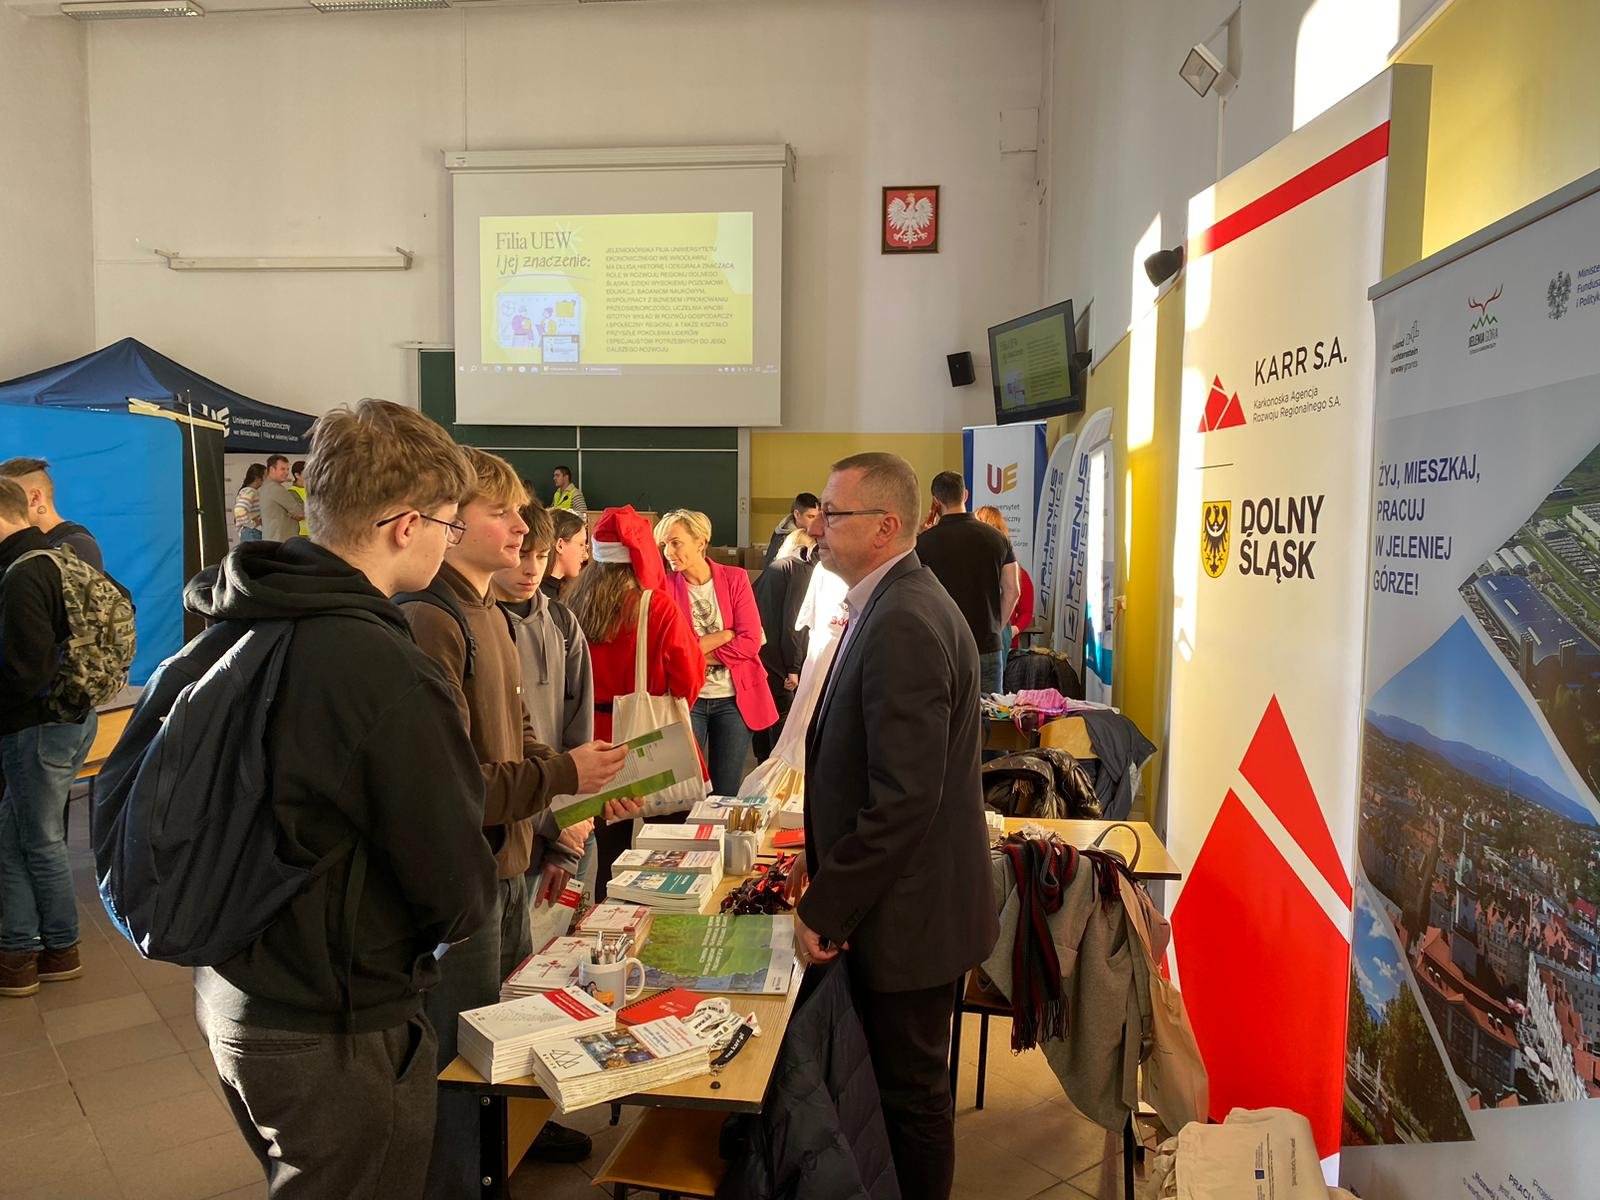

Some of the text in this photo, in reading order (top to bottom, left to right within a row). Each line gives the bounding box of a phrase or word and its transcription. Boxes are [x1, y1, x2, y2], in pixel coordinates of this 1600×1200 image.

[496, 231, 571, 250] Filia UEW
[500, 254, 518, 275] jej
[523, 253, 591, 267] znaczenie:
[1254, 336, 1348, 386] KARR S.A.
[1253, 386, 1318, 409] Karkonoska Agencja
[232, 416, 291, 432] Uniwersytet Ekonomiczny
[1253, 410, 1279, 423] Rozwoju
[1280, 400, 1327, 418] Regionalnego
[986, 462, 1018, 495] UE
[1404, 454, 1480, 484] MIESZKAJ,
[1240, 495, 1325, 535] DOLNY
[1376, 498, 1425, 521] PRACUJ
[1067, 452, 1089, 600] RHENUS
[1238, 531, 1316, 584] ŚLĄSK
[1375, 535, 1452, 560] W JELENIEJ
[1373, 564, 1419, 596] GÓRZE!
